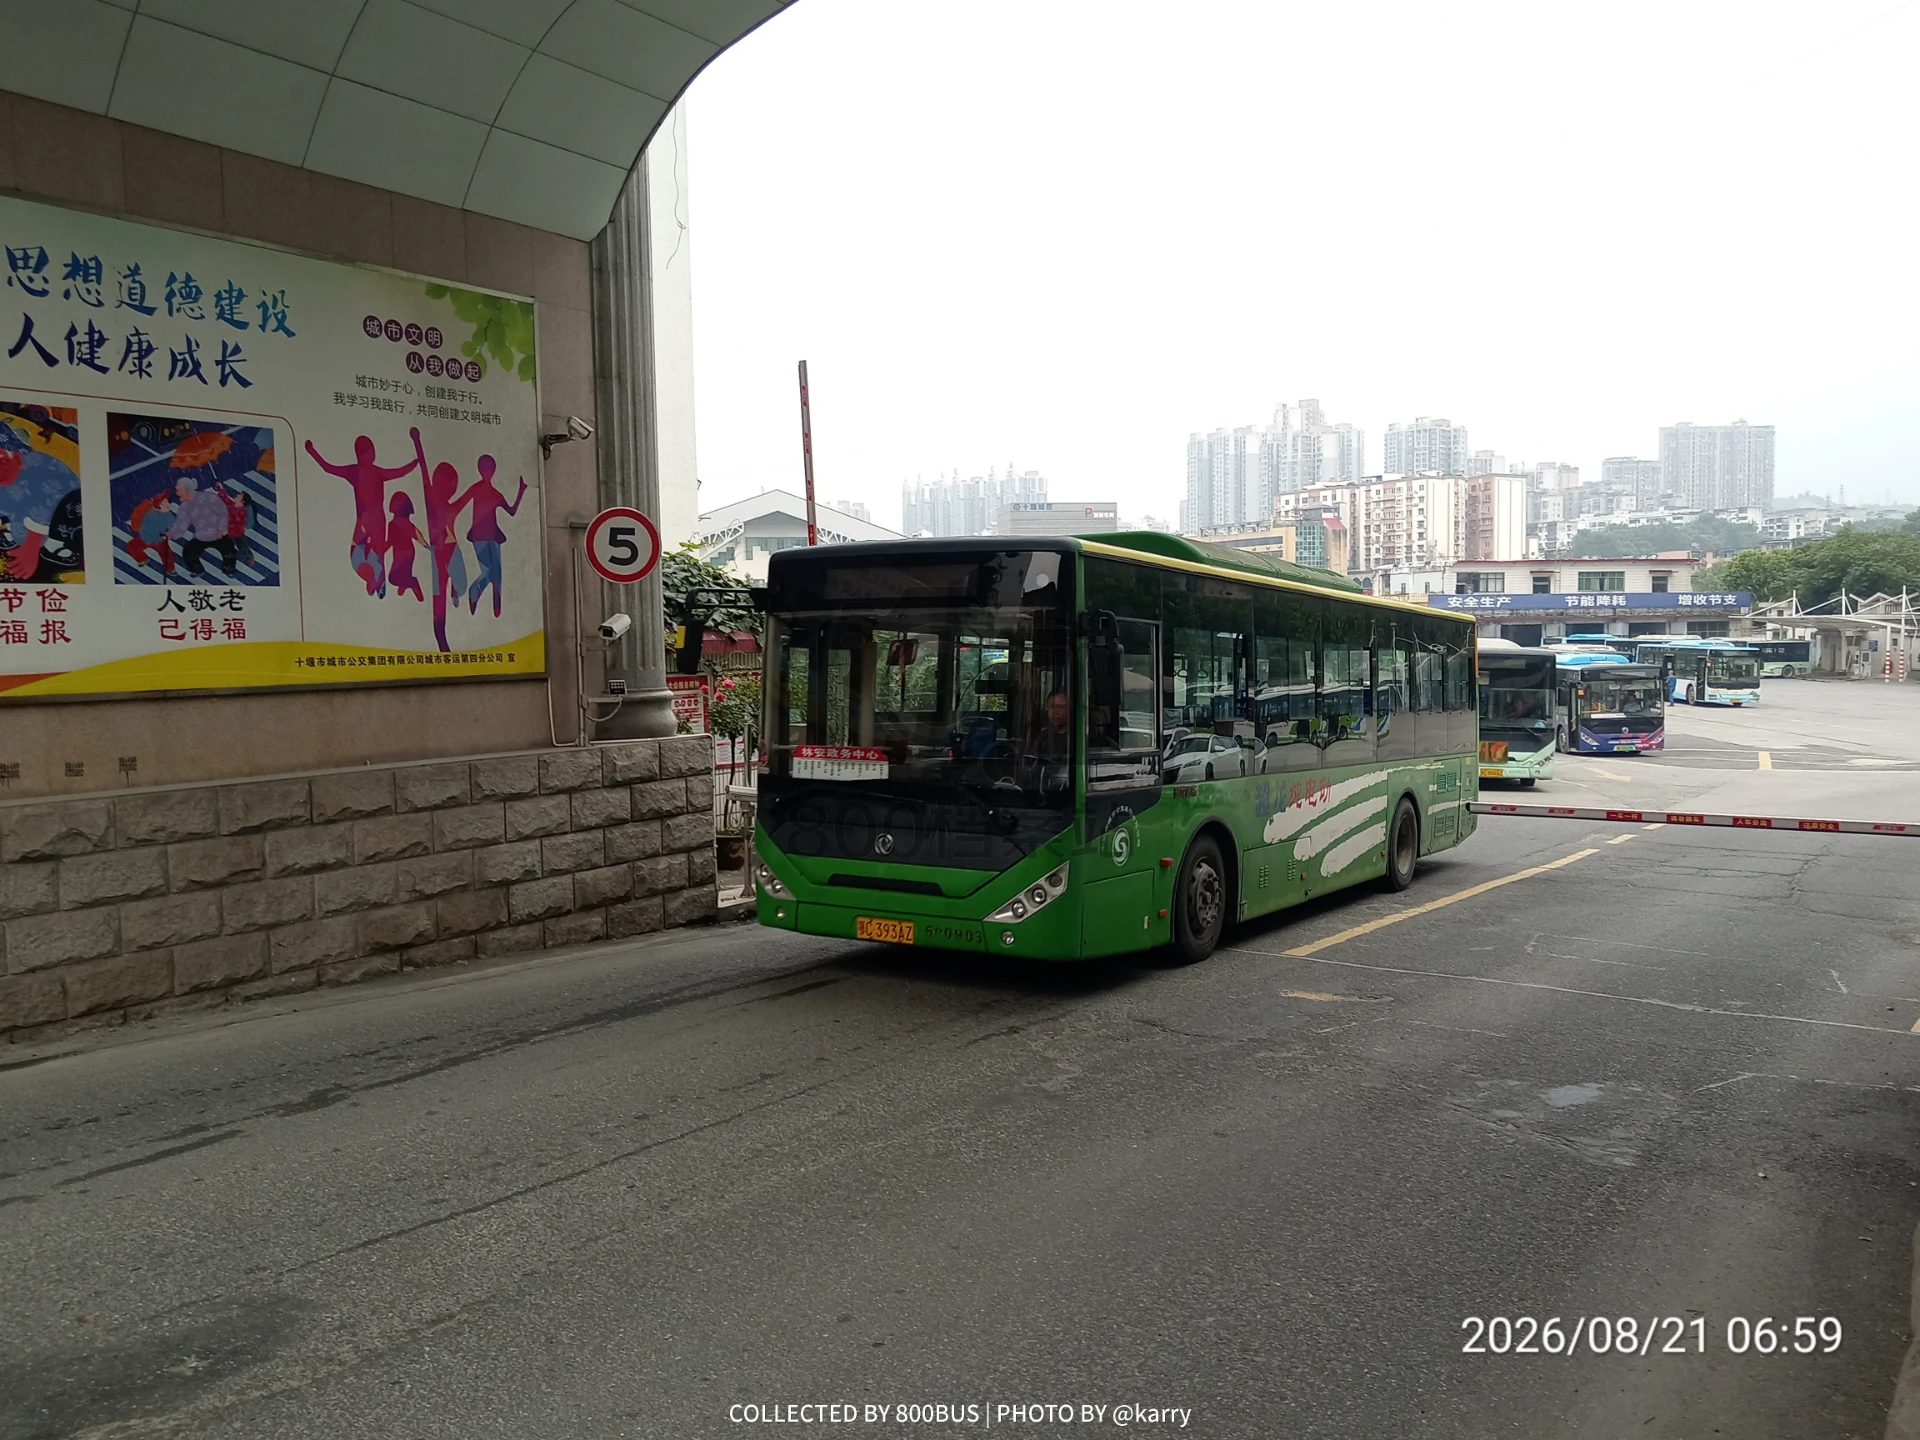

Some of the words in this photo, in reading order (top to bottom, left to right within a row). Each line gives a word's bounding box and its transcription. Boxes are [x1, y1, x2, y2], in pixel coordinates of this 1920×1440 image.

[5, 245, 297, 338] 思想道德建设
[365, 318, 442, 347] 城市文明
[8, 312, 254, 389] 人健康成长
[408, 354, 480, 380] 从我做起
[333, 391, 502, 426] 我学习我践行，共同创建文明城市
[607, 526, 640, 567] 5
[157, 588, 247, 612] 人敬老
[1447, 595, 1512, 608] 安全生产
[1564, 595, 1627, 607] 节能降耗
[1677, 594, 1738, 606] 增收节支
[157, 618, 247, 640] 己得福
[295, 653, 504, 668] 十堰市城市公交集团有限公司城市客运第四分公司
[507, 653, 516, 663] 宣
